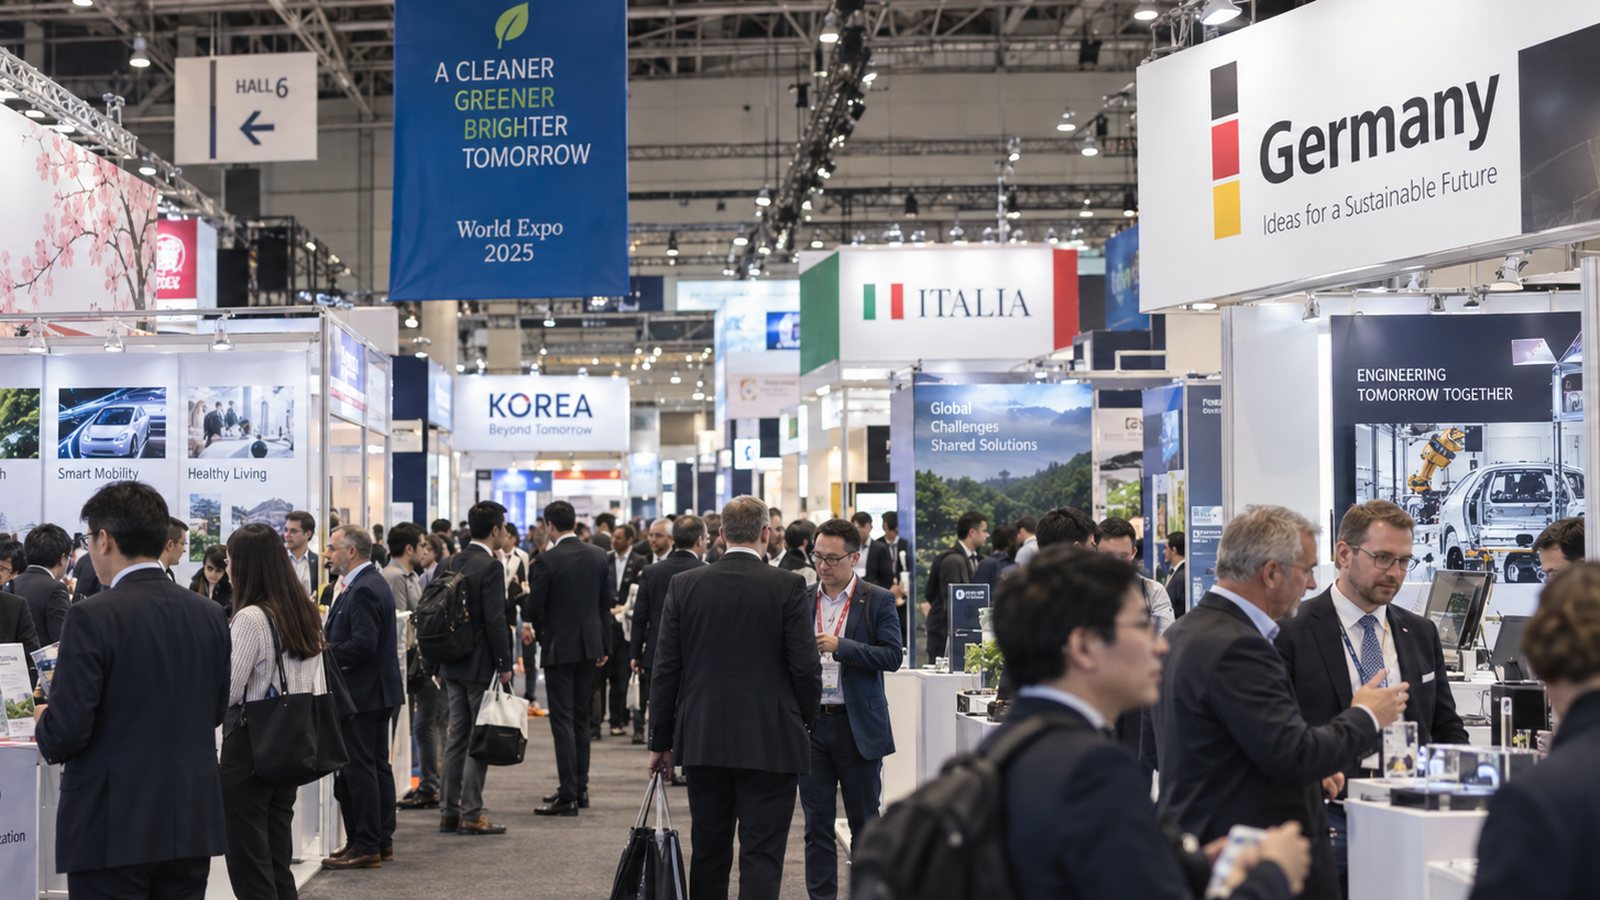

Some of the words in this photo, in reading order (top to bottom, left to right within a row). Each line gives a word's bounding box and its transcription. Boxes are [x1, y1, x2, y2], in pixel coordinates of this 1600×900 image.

[434, 62, 450, 83] A
[456, 57, 555, 82] CLEANER
[235, 78, 273, 95] HALL
[275, 77, 290, 99] 6
[455, 87, 555, 112] GREENER
[464, 115, 568, 140] BRIGHTER
[1260, 74, 1501, 185] Germany
[463, 144, 592, 168] TOMORROW
[1263, 212, 1301, 236] Ideas
[1305, 203, 1327, 226] for
[1331, 203, 1341, 220] a
[1346, 178, 1436, 217] Sustainable
[1441, 166, 1498, 195] Future
[456, 219, 511, 239] World
[517, 219, 564, 239] Expo
[484, 243, 534, 264] 2025
[919, 288, 1031, 319] ITALIA
[1357, 368, 1446, 382] ENGINEERING
[1357, 388, 1439, 402] TOMORROW
[1443, 387, 1513, 401] TOGETHER
[489, 393, 592, 418] KOREA
[930, 401, 972, 416] Global
[489, 423, 531, 437] Beyond
[535, 423, 592, 436] Tomorrow
[930, 418, 1000, 436] Challenges
[931, 438, 976, 453] Shared
[979, 437, 1038, 453] Solutions
[58, 467, 91, 481] Smart
[94, 466, 140, 482] Mobility
[188, 467, 230, 483] Healthy
[233, 467, 267, 483] Living
